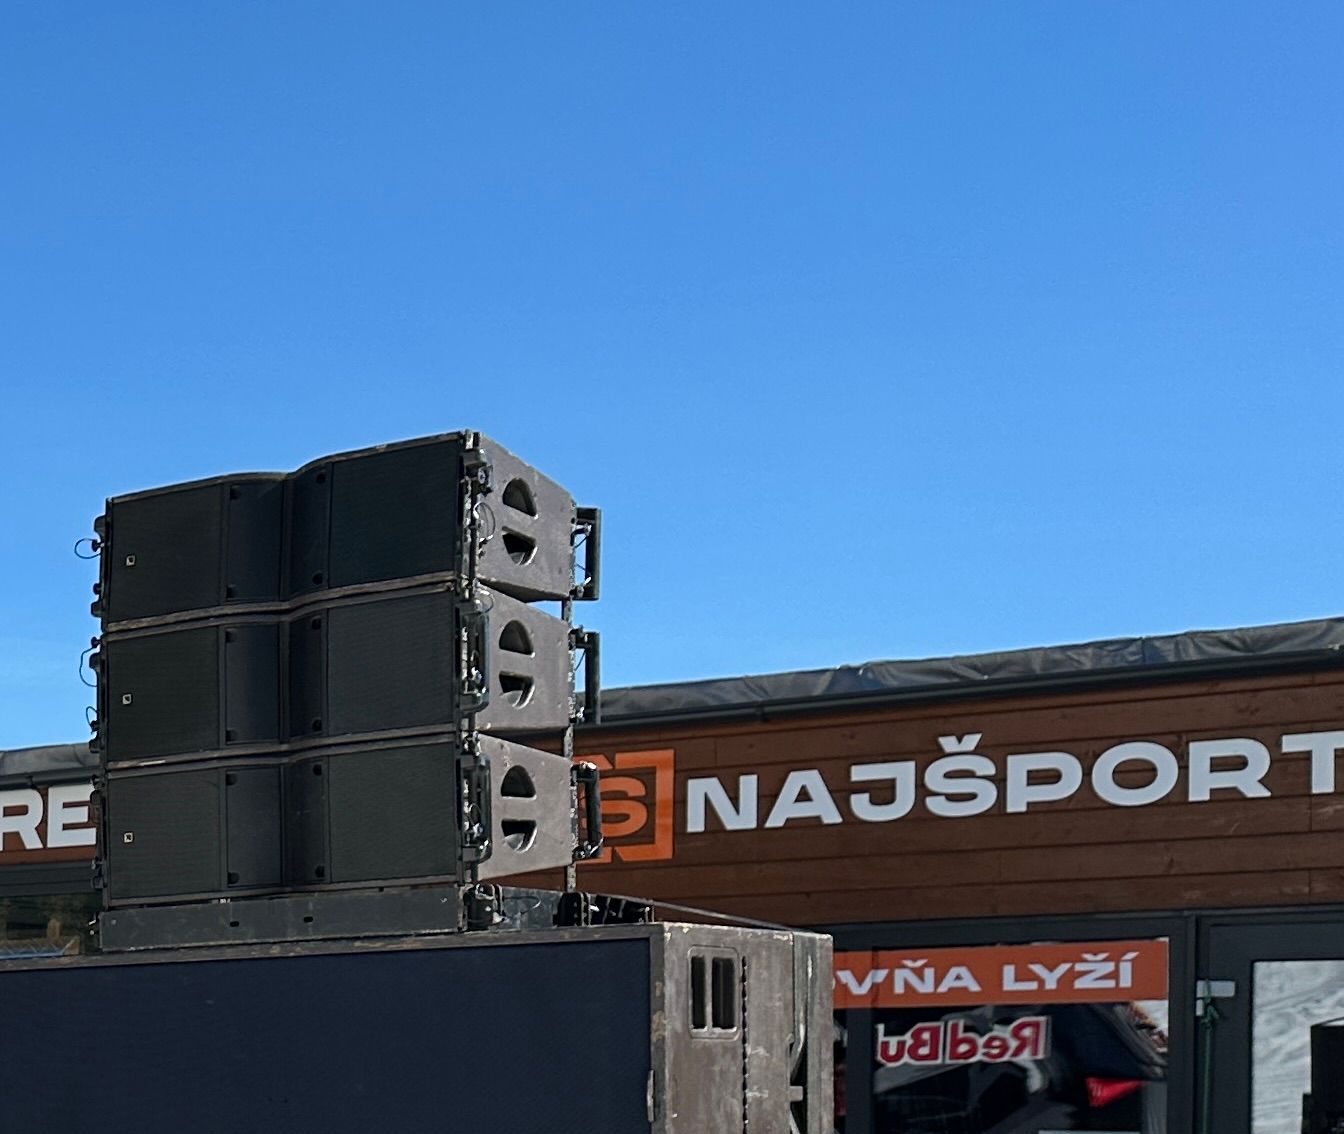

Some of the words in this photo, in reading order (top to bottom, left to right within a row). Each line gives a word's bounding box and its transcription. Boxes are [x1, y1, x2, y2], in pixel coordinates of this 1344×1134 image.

[686, 731, 1344, 834] NAJŠPORT
[832, 958, 981, 995] VŇA
[1002, 951, 1140, 992] LYŽÍ
